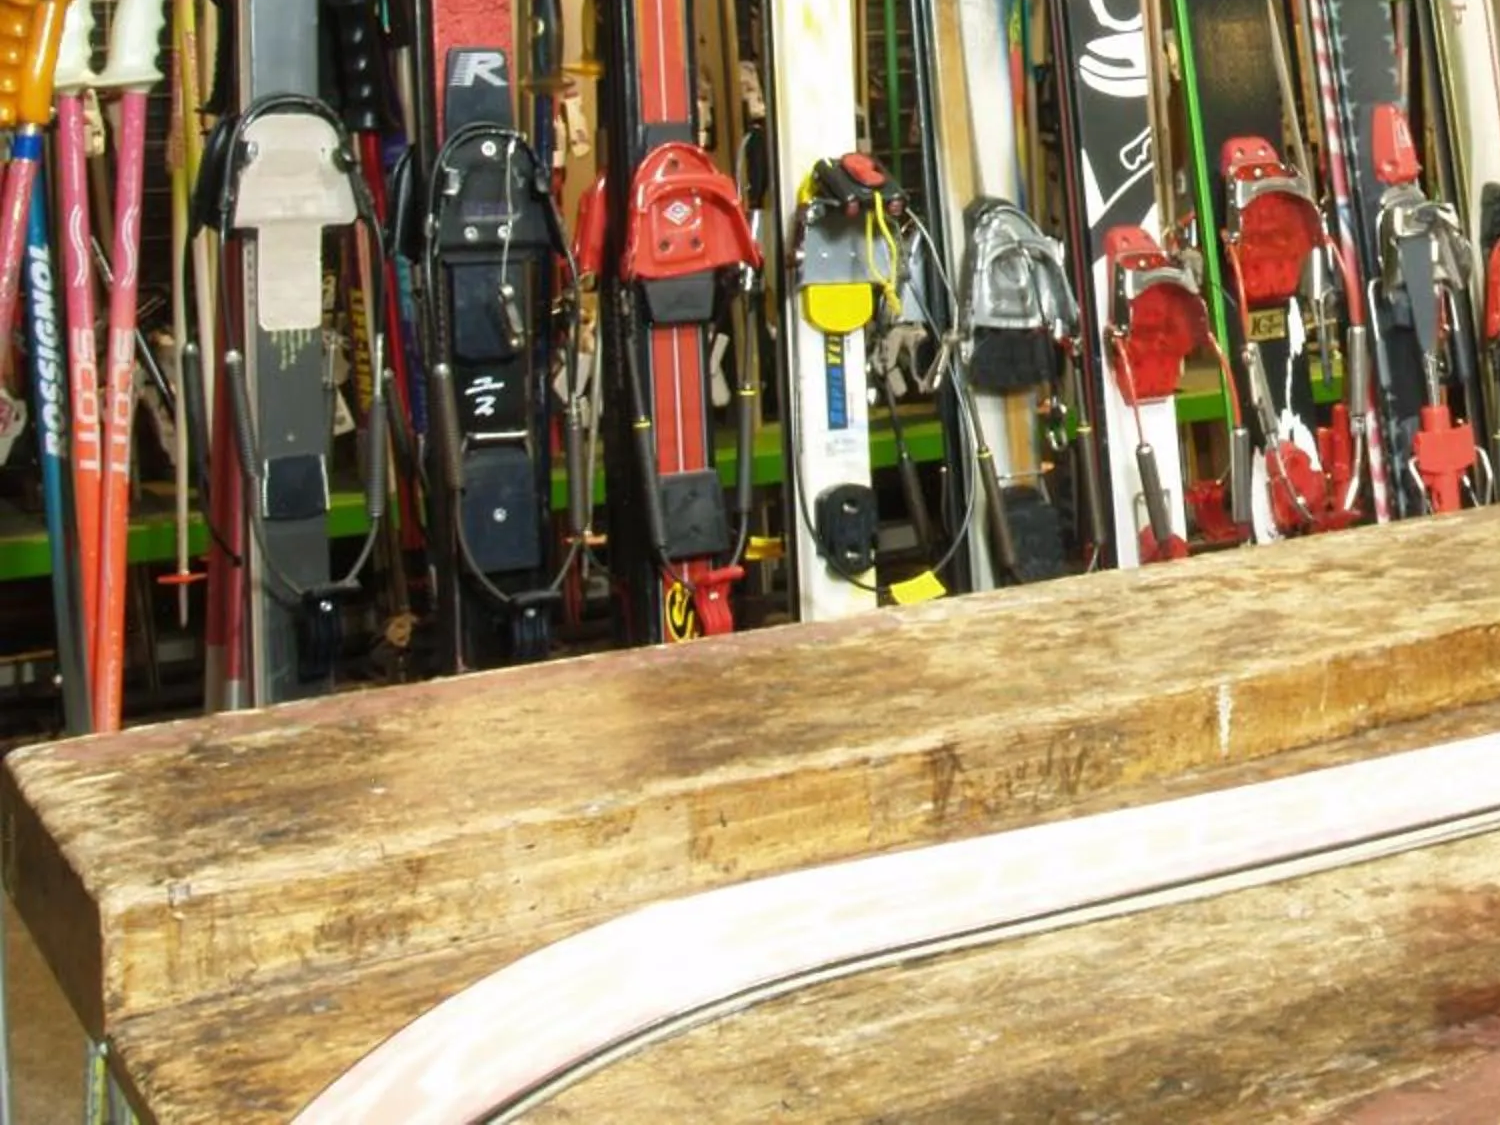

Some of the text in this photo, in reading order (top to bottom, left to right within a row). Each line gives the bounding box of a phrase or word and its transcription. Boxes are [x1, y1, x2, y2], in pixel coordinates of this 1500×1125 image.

[448, 51, 509, 86] R
[27, 243, 68, 458] ROSSIGNOL
[73, 327, 102, 473] SCOTT
[109, 327, 134, 475] SCOTT
